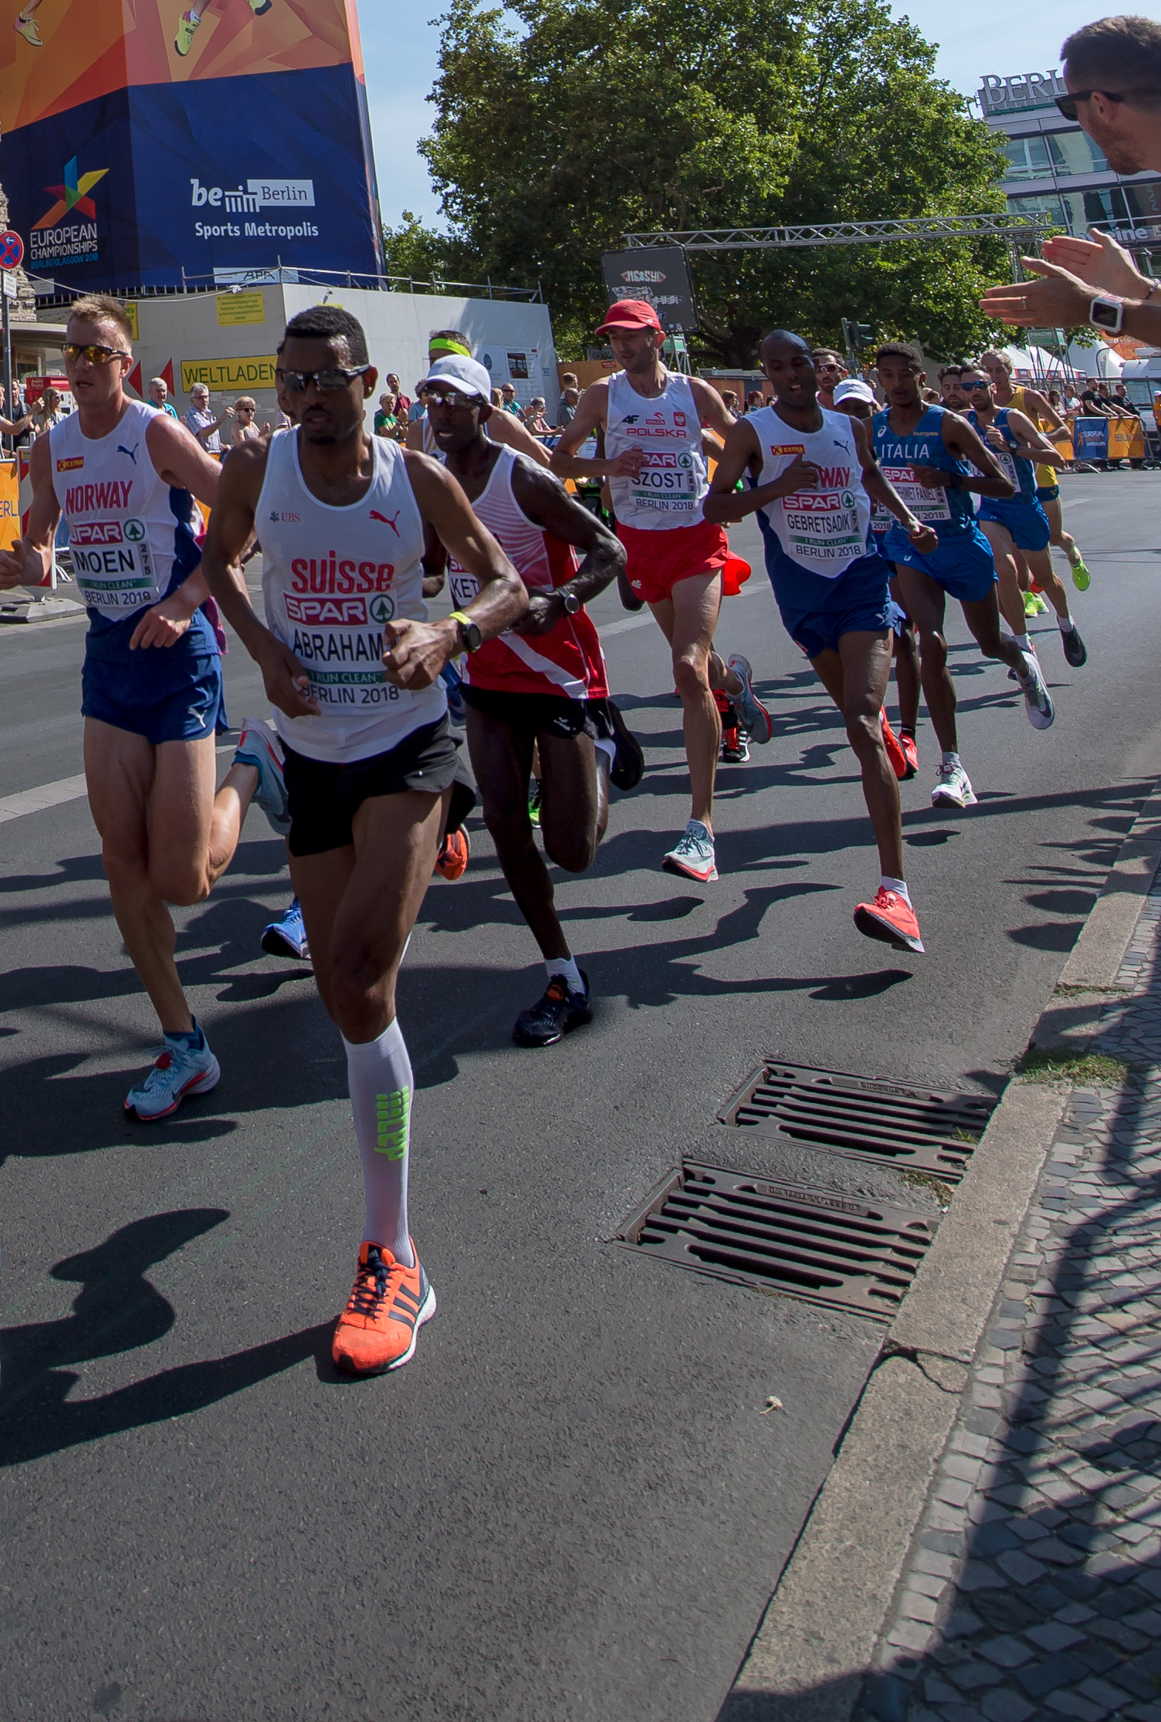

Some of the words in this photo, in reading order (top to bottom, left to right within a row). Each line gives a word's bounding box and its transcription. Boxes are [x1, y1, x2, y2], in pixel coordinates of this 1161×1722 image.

[979, 68, 1068, 106] BERL
[190, 178, 223, 206] be
[261, 186, 308, 201] Berlin
[30, 223, 98, 248] EUROPEAN
[195, 222, 241, 240] Sports
[244, 221, 319, 240] Metropolis
[30, 240, 98, 260] CHAMPIONSHIPS
[184, 363, 277, 384] WELTLADEN
[626, 428, 686, 438] POLSKA
[645, 454, 675, 466] PAR
[881, 443, 930, 459] ITALIA
[819, 467, 851, 488] WAY
[66, 480, 133, 515] NORWAY
[635, 498, 669, 510] BERLIN
[672, 502, 693, 510] 2018
[784, 495, 840, 509] SPAR
[281, 512, 301, 523] UBS
[787, 513, 851, 534] GEBRETSADIK
[922, 511, 945, 520] 2018
[796, 545, 835, 558] BERLIN
[838, 545, 861, 557] 2018
[809, 538, 825, 546] RUN
[73, 549, 136, 574] MOEN
[140, 544, 151, 575] 275
[93, 581, 107, 589] RUN
[451, 578, 481, 598] KET
[85, 591, 119, 605] BERLIN
[122, 592, 151, 606] 2018
[286, 597, 365, 622] SPAR
[293, 629, 384, 662] ABRAHAM
[317, 673, 338, 682] RUN
[303, 684, 356, 704] BERLIN
[361, 685, 399, 704] 2018
